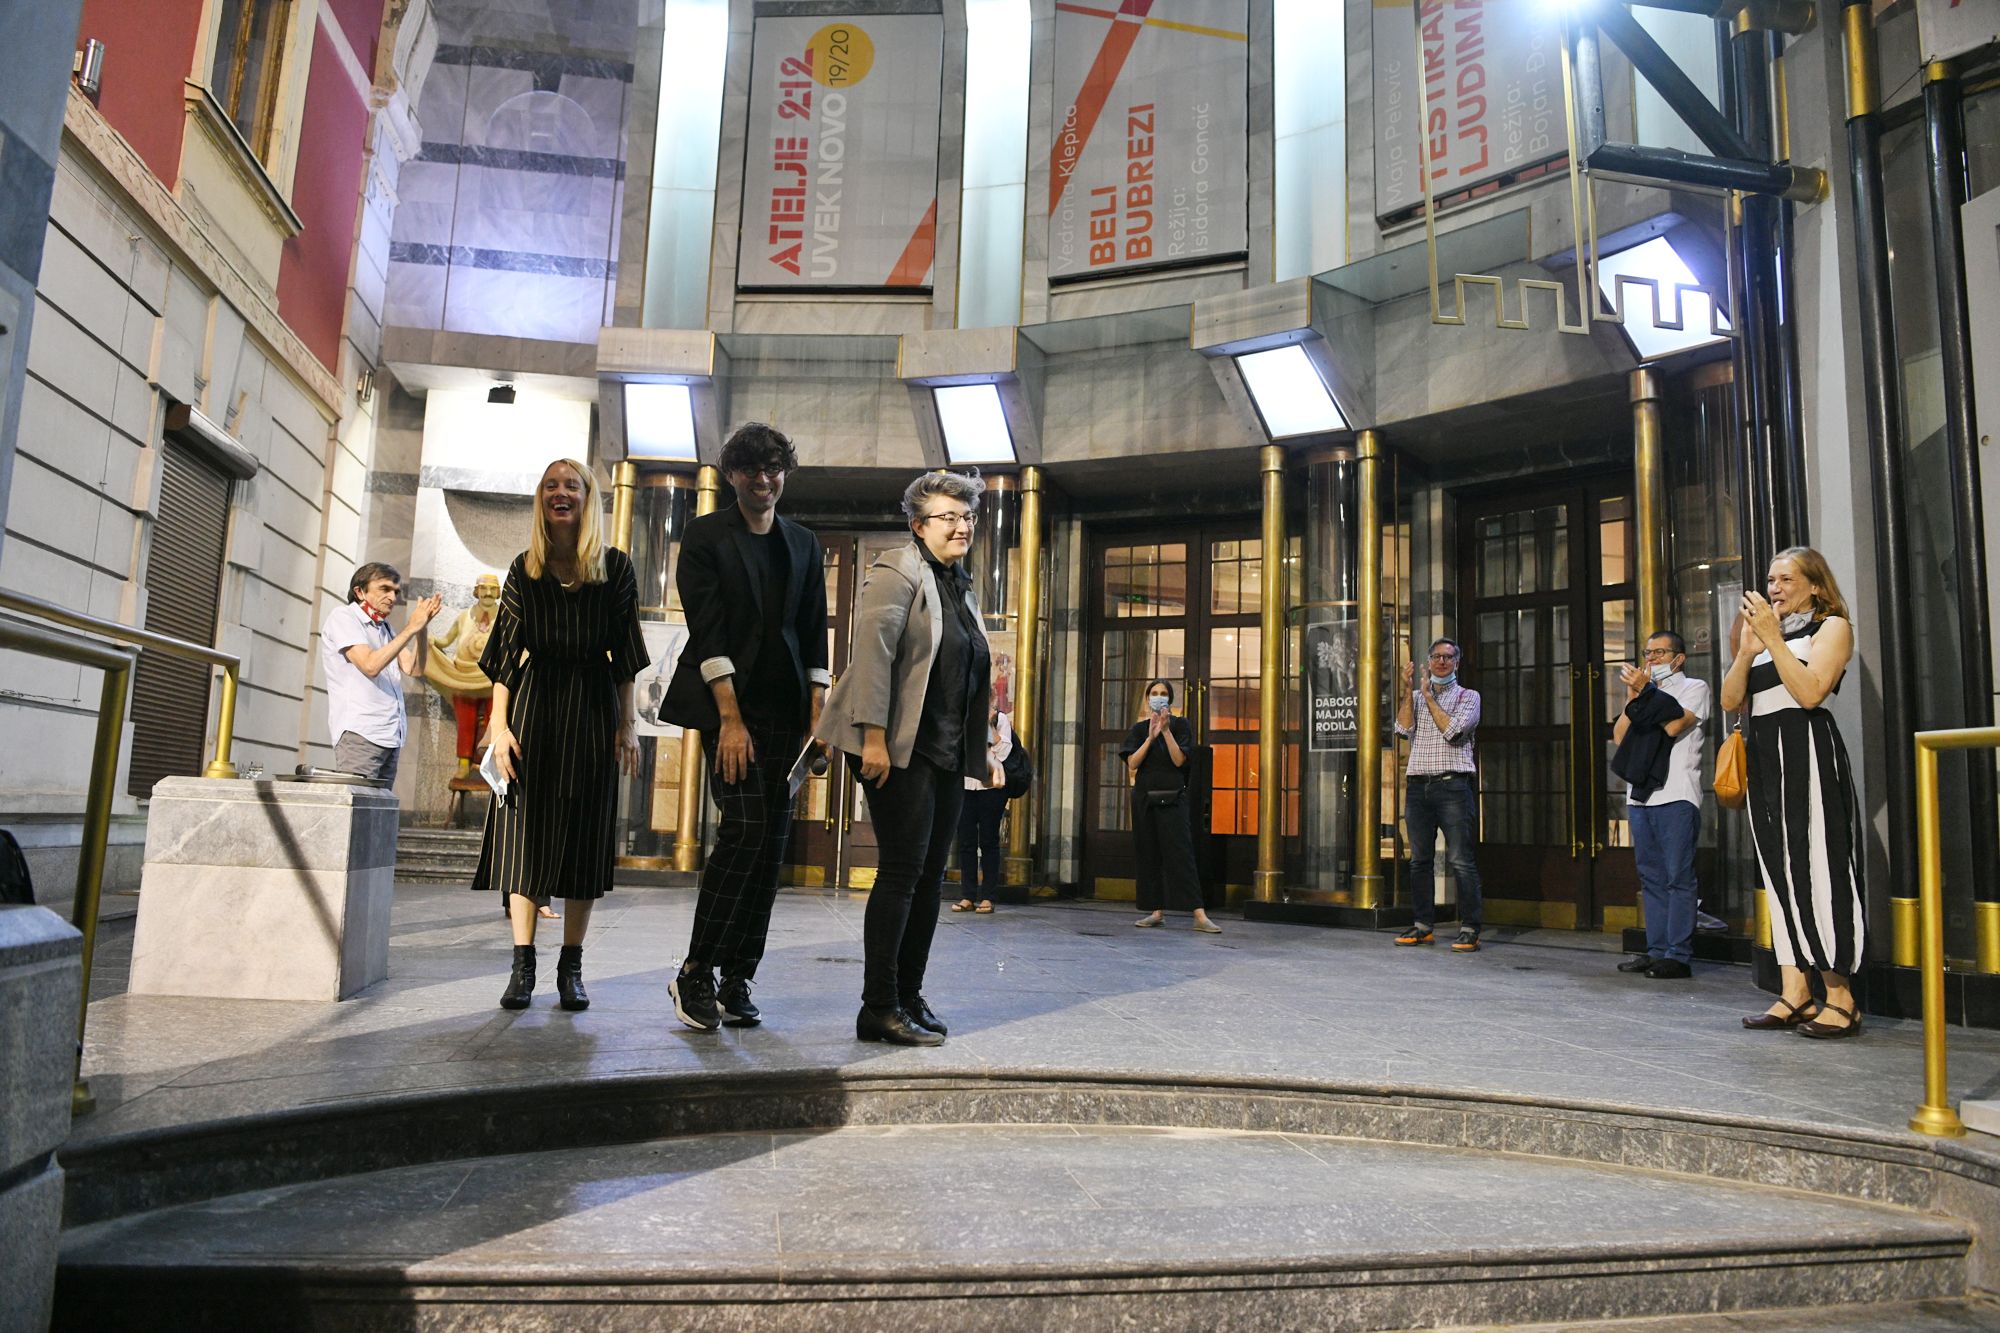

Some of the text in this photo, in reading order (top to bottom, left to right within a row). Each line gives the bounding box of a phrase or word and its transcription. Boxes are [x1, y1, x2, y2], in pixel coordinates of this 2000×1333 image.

[828, 29, 849, 86] 19/20
[1384, 60, 1408, 206] Maja Pelević
[1503, 80, 1526, 163] Režija:
[1529, 79, 1553, 154] Bojan
[768, 137, 808, 277] ATELJE
[811, 92, 848, 279] UVEK NOVO
[1057, 104, 1080, 271] Vedrana Klepica
[1126, 103, 1155, 260] BUBREZI
[1168, 187, 1190, 257] Režija:
[1191, 180, 1209, 254] Isidora
[1090, 185, 1117, 266] BELI
[1315, 709, 1354, 720] MAJKA
[1315, 721, 1357, 732] RODILA
